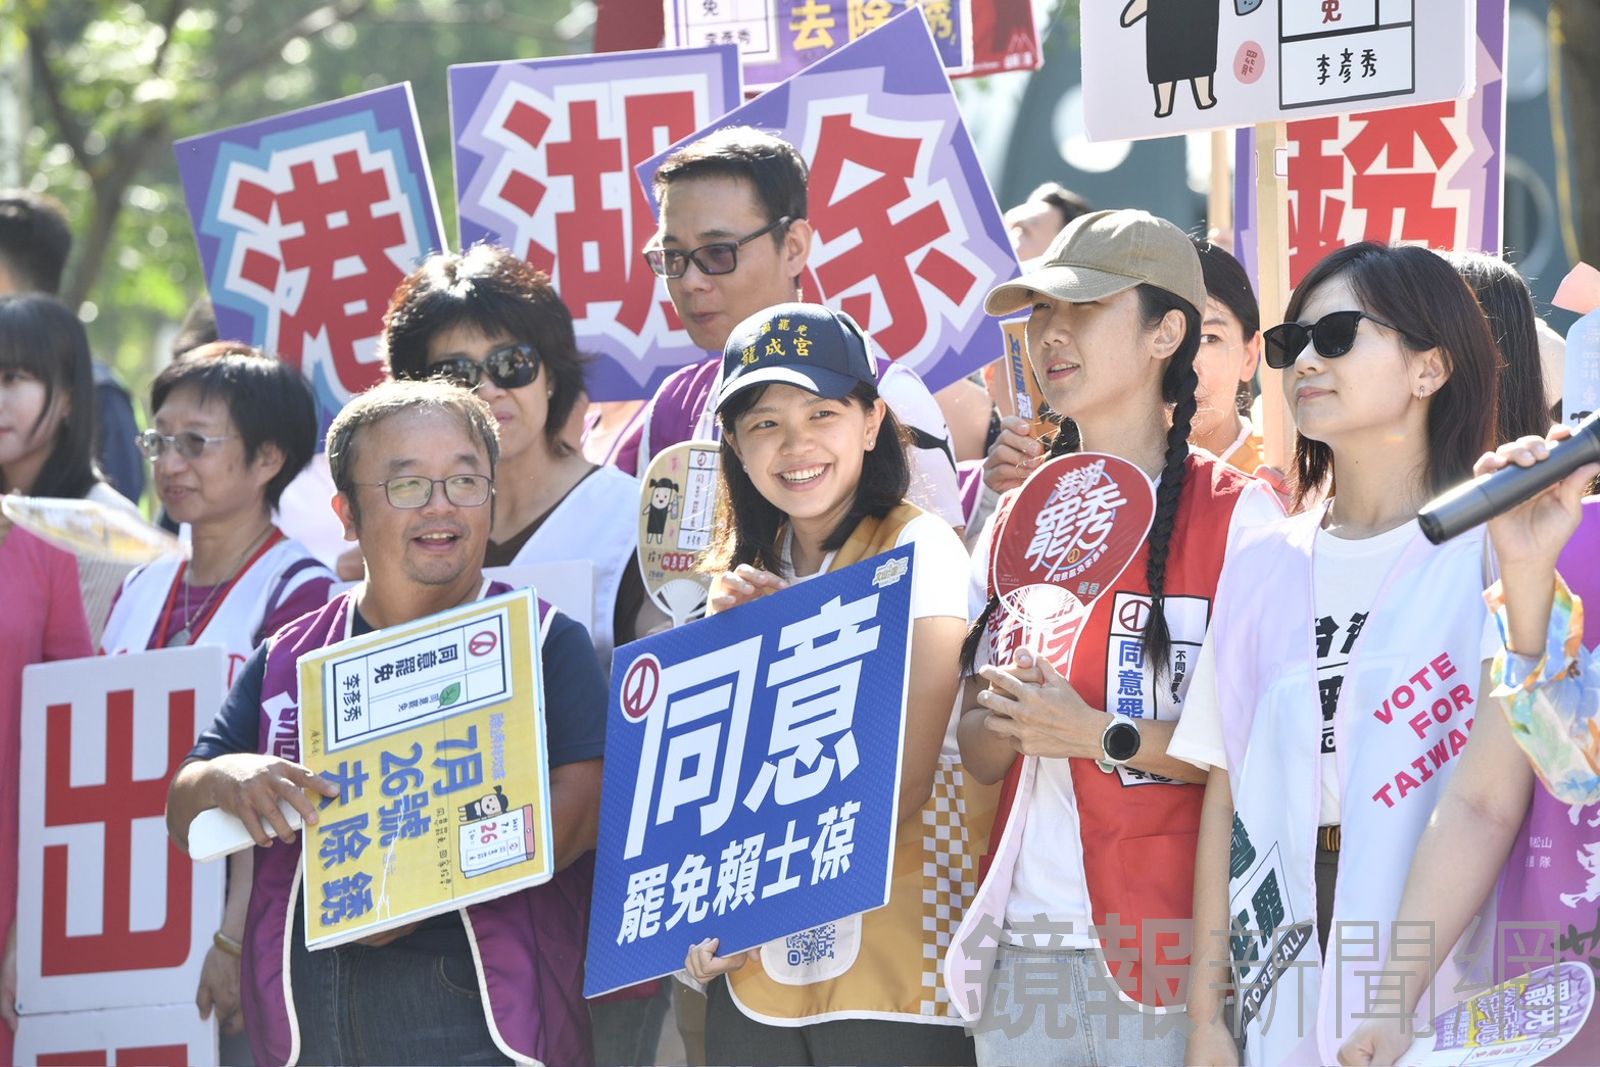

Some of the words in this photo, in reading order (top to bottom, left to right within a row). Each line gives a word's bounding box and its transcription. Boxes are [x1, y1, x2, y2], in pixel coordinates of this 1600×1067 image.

[1317, 48, 1377, 86] 李彥秀
[498, 91, 696, 336] 湖
[233, 149, 408, 394] 港
[741, 337, 813, 367] 龍成宮
[1055, 458, 1106, 500] 港湖
[343, 673, 362, 722] 李彥秀
[374, 644, 459, 684] 同意罷免
[1373, 652, 1457, 725] VOTE
[624, 593, 882, 861] 同意
[1408, 684, 1475, 740] FOR
[378, 742, 432, 848] 26號
[432, 725, 484, 797] 7月
[1372, 718, 1475, 809] TAIWA
[41, 688, 196, 978] 出
[318, 760, 375, 926] 去除銹
[480, 822, 498, 844] 26
[616, 801, 861, 947] 罷免賴士葆
[1244, 988, 1262, 1012] TO
[1260, 927, 1305, 986] RECALL
